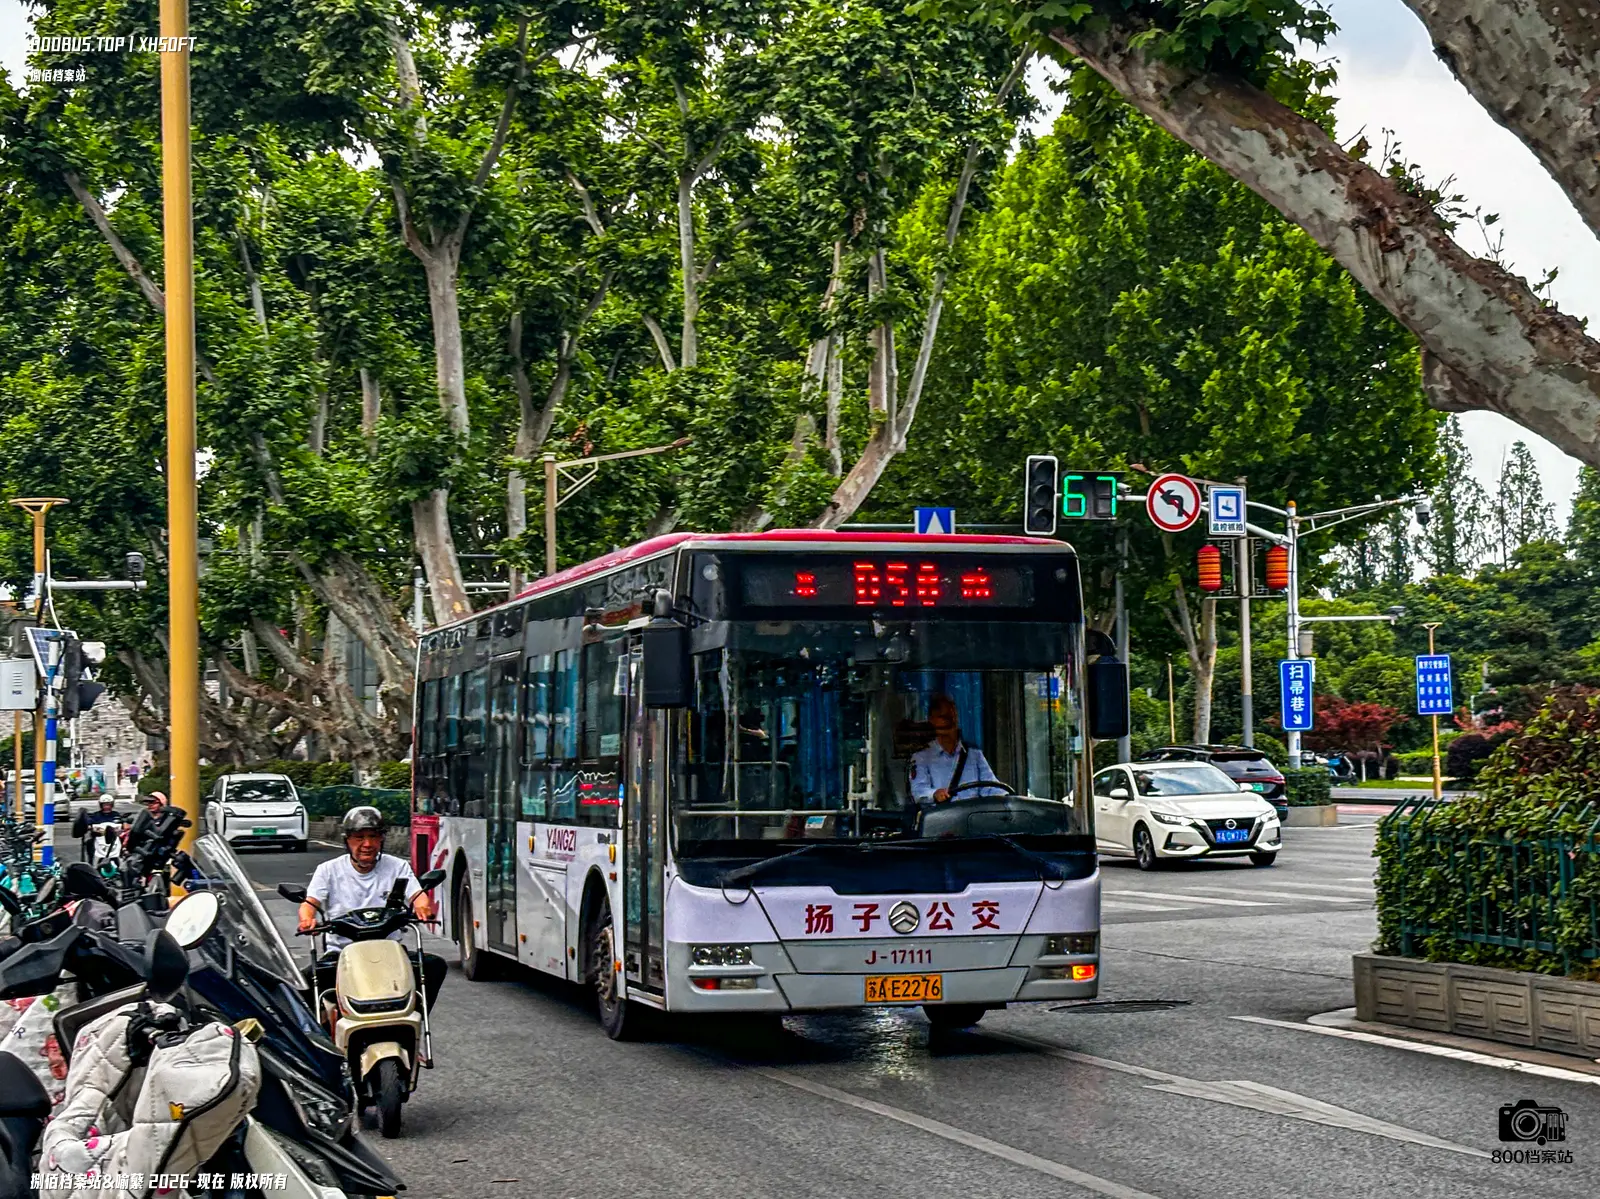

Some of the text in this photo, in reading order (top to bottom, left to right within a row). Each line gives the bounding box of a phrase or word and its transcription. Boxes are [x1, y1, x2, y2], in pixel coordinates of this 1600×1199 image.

[1062, 475, 1117, 517] 67
[1289, 664, 1305, 711] 扫帚巷
[547, 828, 577, 851] YANGZI
[865, 950, 932, 964] J-17111
